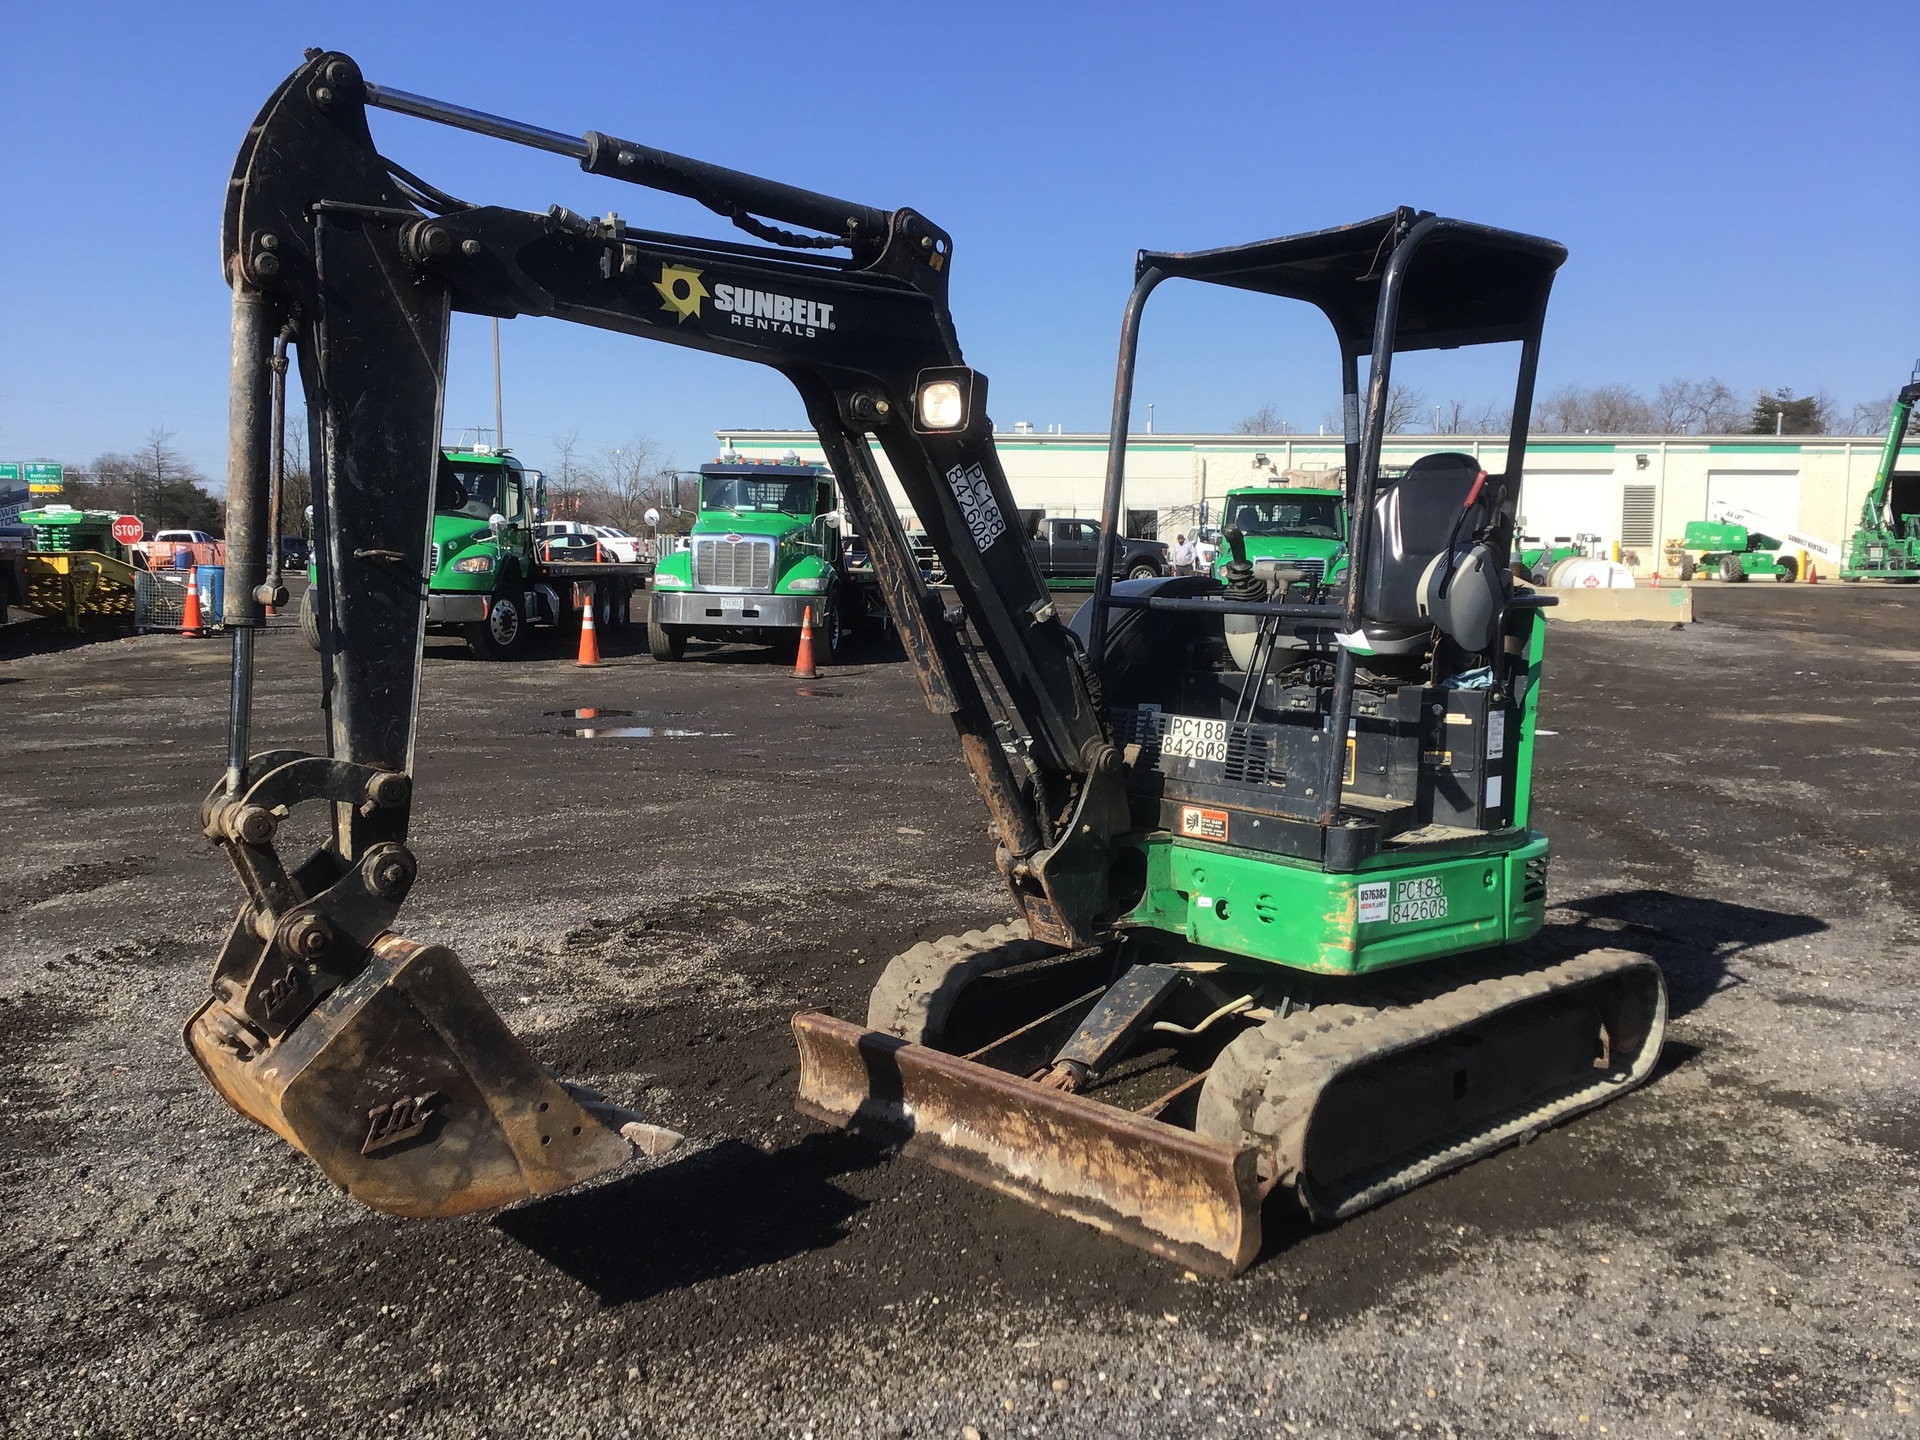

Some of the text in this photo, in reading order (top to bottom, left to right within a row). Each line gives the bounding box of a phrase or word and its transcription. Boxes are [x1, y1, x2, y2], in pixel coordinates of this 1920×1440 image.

[731, 314, 816, 338] RENTALS
[967, 465, 1004, 535] PC188
[115, 524, 141, 536] STOP
[1788, 534, 1828, 555] SUNBELT RENTALS
[1172, 718, 1224, 740] PC188
[1360, 888, 1387, 901] U576383
[1397, 877, 1442, 900] PC188
